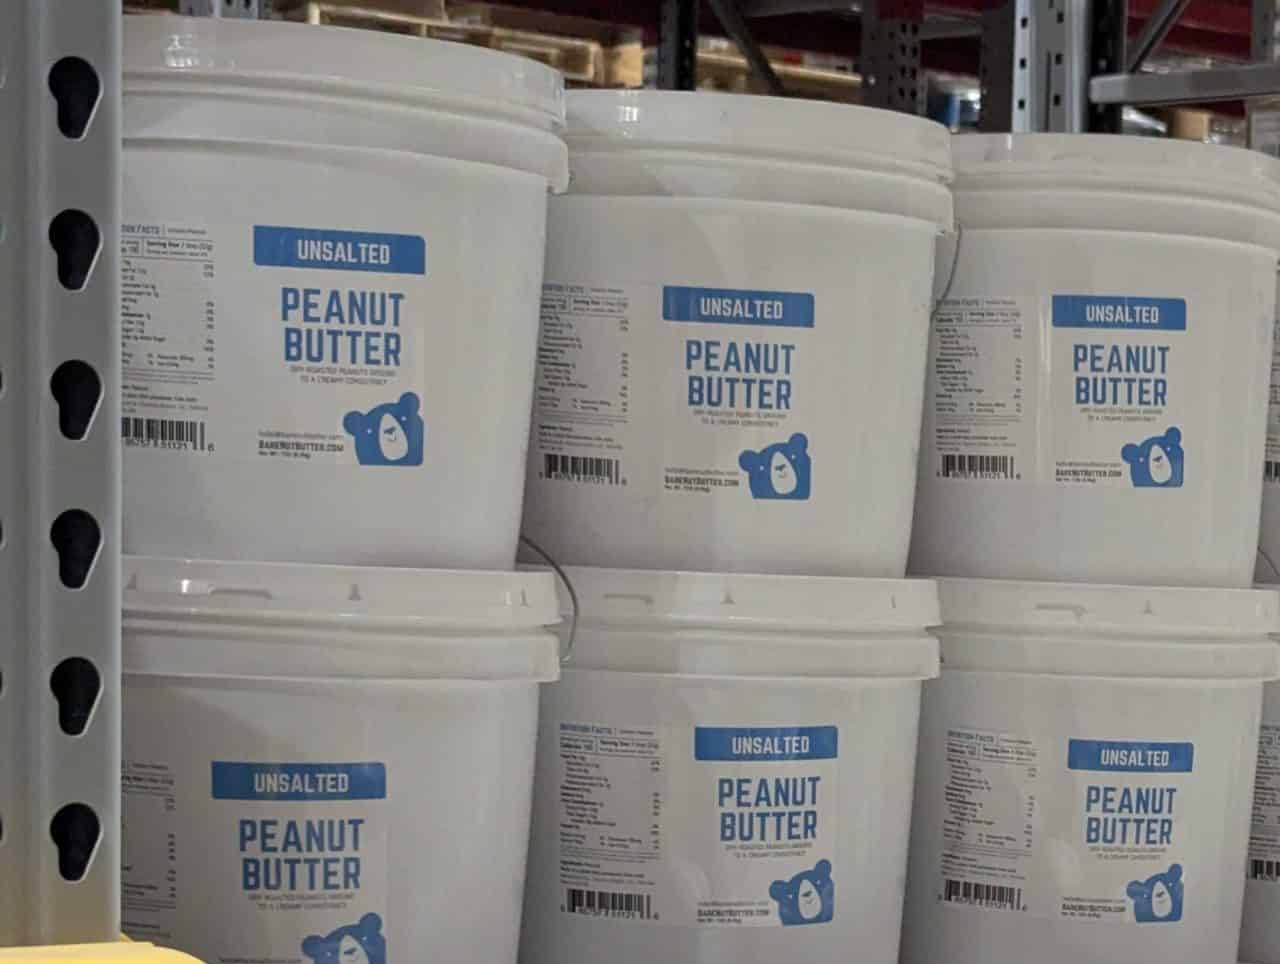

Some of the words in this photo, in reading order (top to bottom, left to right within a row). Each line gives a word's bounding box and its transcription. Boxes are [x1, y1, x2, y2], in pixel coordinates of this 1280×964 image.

[297, 239, 390, 265] UNSALTED
[281, 287, 405, 326] PEANUT
[700, 297, 783, 320] UNSALTED
[1086, 304, 1160, 323] UNSALTED
[284, 328, 401, 366] BUTTER
[686, 340, 795, 374] PEANUT
[1073, 344, 1170, 374] PEANUT
[688, 375, 792, 410] BUTTER
[1075, 376, 1168, 406] BUTTER
[732, 736, 810, 754] UNSALTED
[1100, 749, 1170, 766] UNSALTED
[254, 772, 349, 793] UNSALTED
[718, 776, 821, 808] PEANUT
[1086, 785, 1177, 814] PEANUT
[239, 818, 364, 852] PEANUT
[720, 810, 817, 841] BUTTER
[1086, 817, 1173, 845] BUTTER
[242, 857, 361, 890] BUTTER
